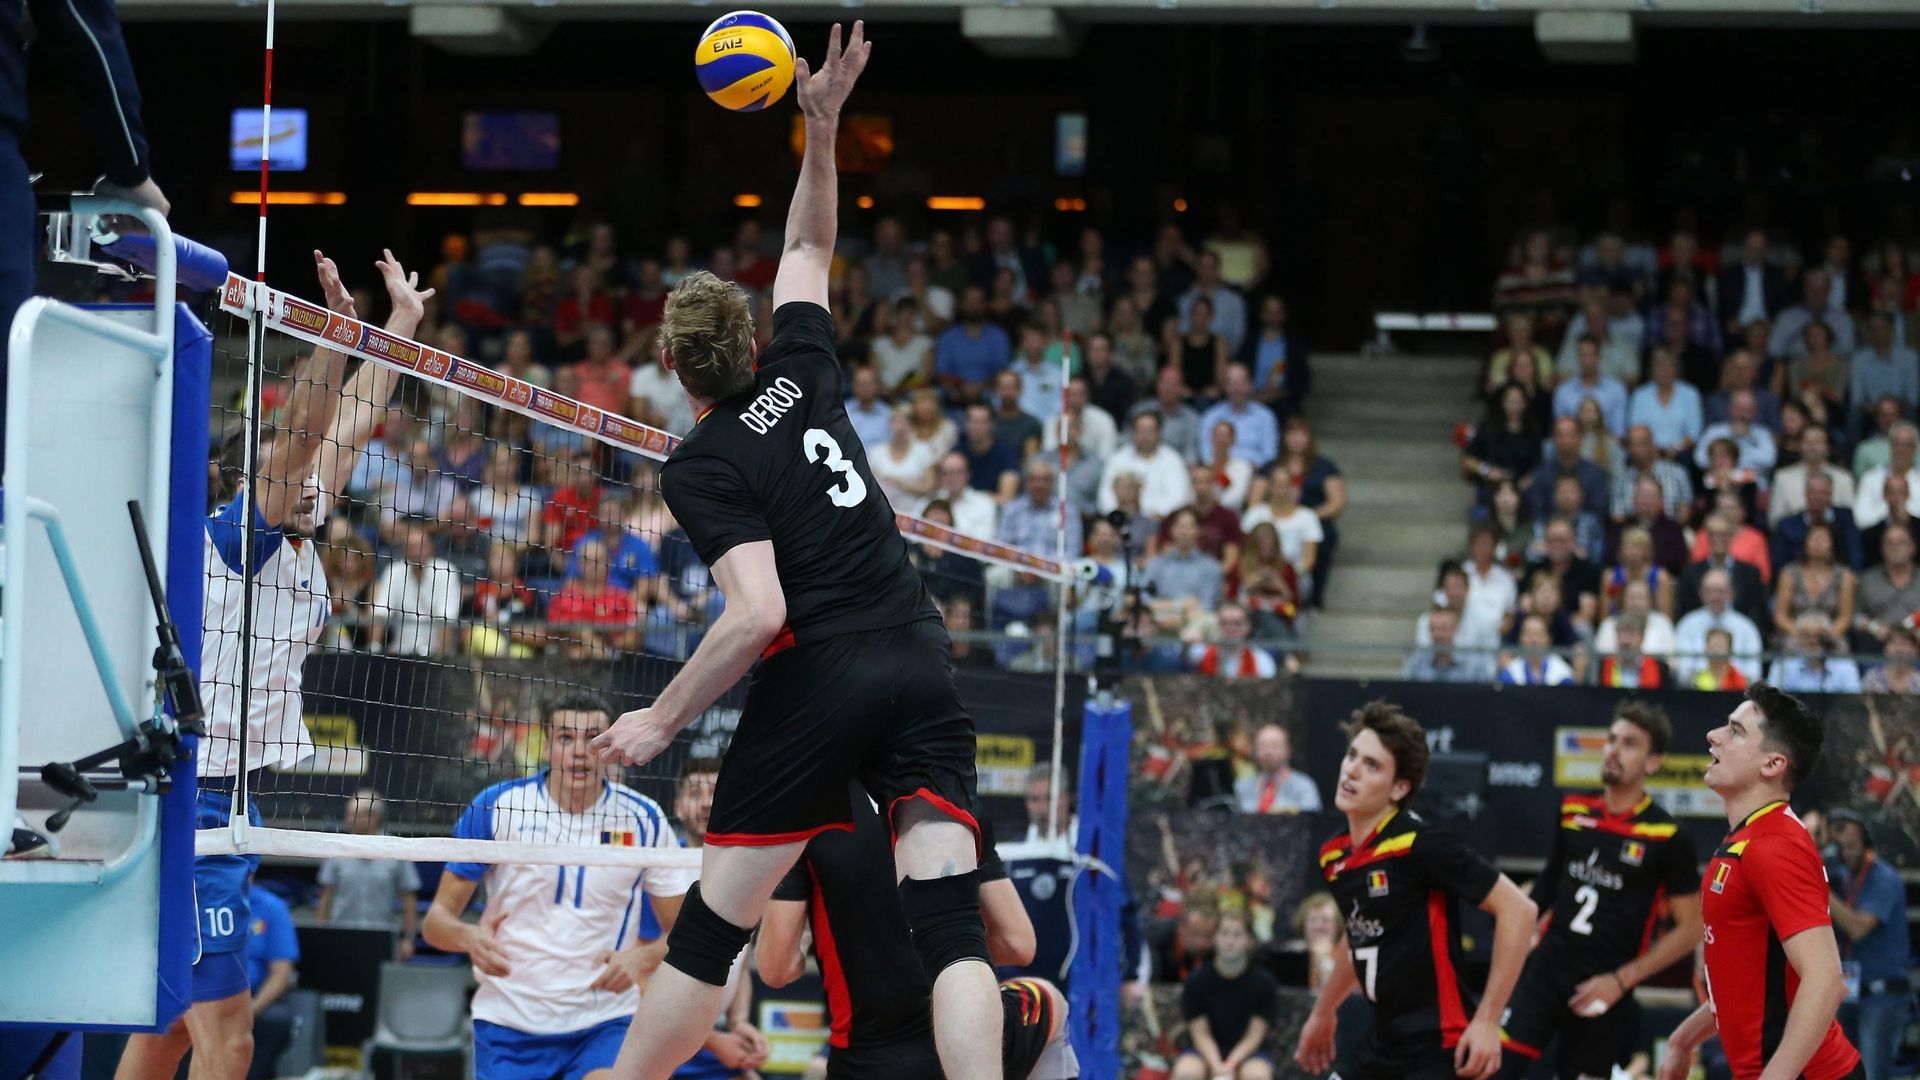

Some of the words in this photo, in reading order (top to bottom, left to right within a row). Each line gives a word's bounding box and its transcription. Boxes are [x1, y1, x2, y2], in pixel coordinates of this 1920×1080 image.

[713, 37, 743, 53] FIVB
[291, 307, 317, 328] VOLLEYBALL
[332, 320, 356, 343] ethias
[367, 334, 378, 349] FAIR
[377, 338, 389, 353] PLAY
[423, 355, 444, 375] ethias
[739, 376, 803, 435] DEROO
[803, 428, 867, 508] 3
[1569, 885, 1599, 935] 2
[205, 907, 234, 937] 10
